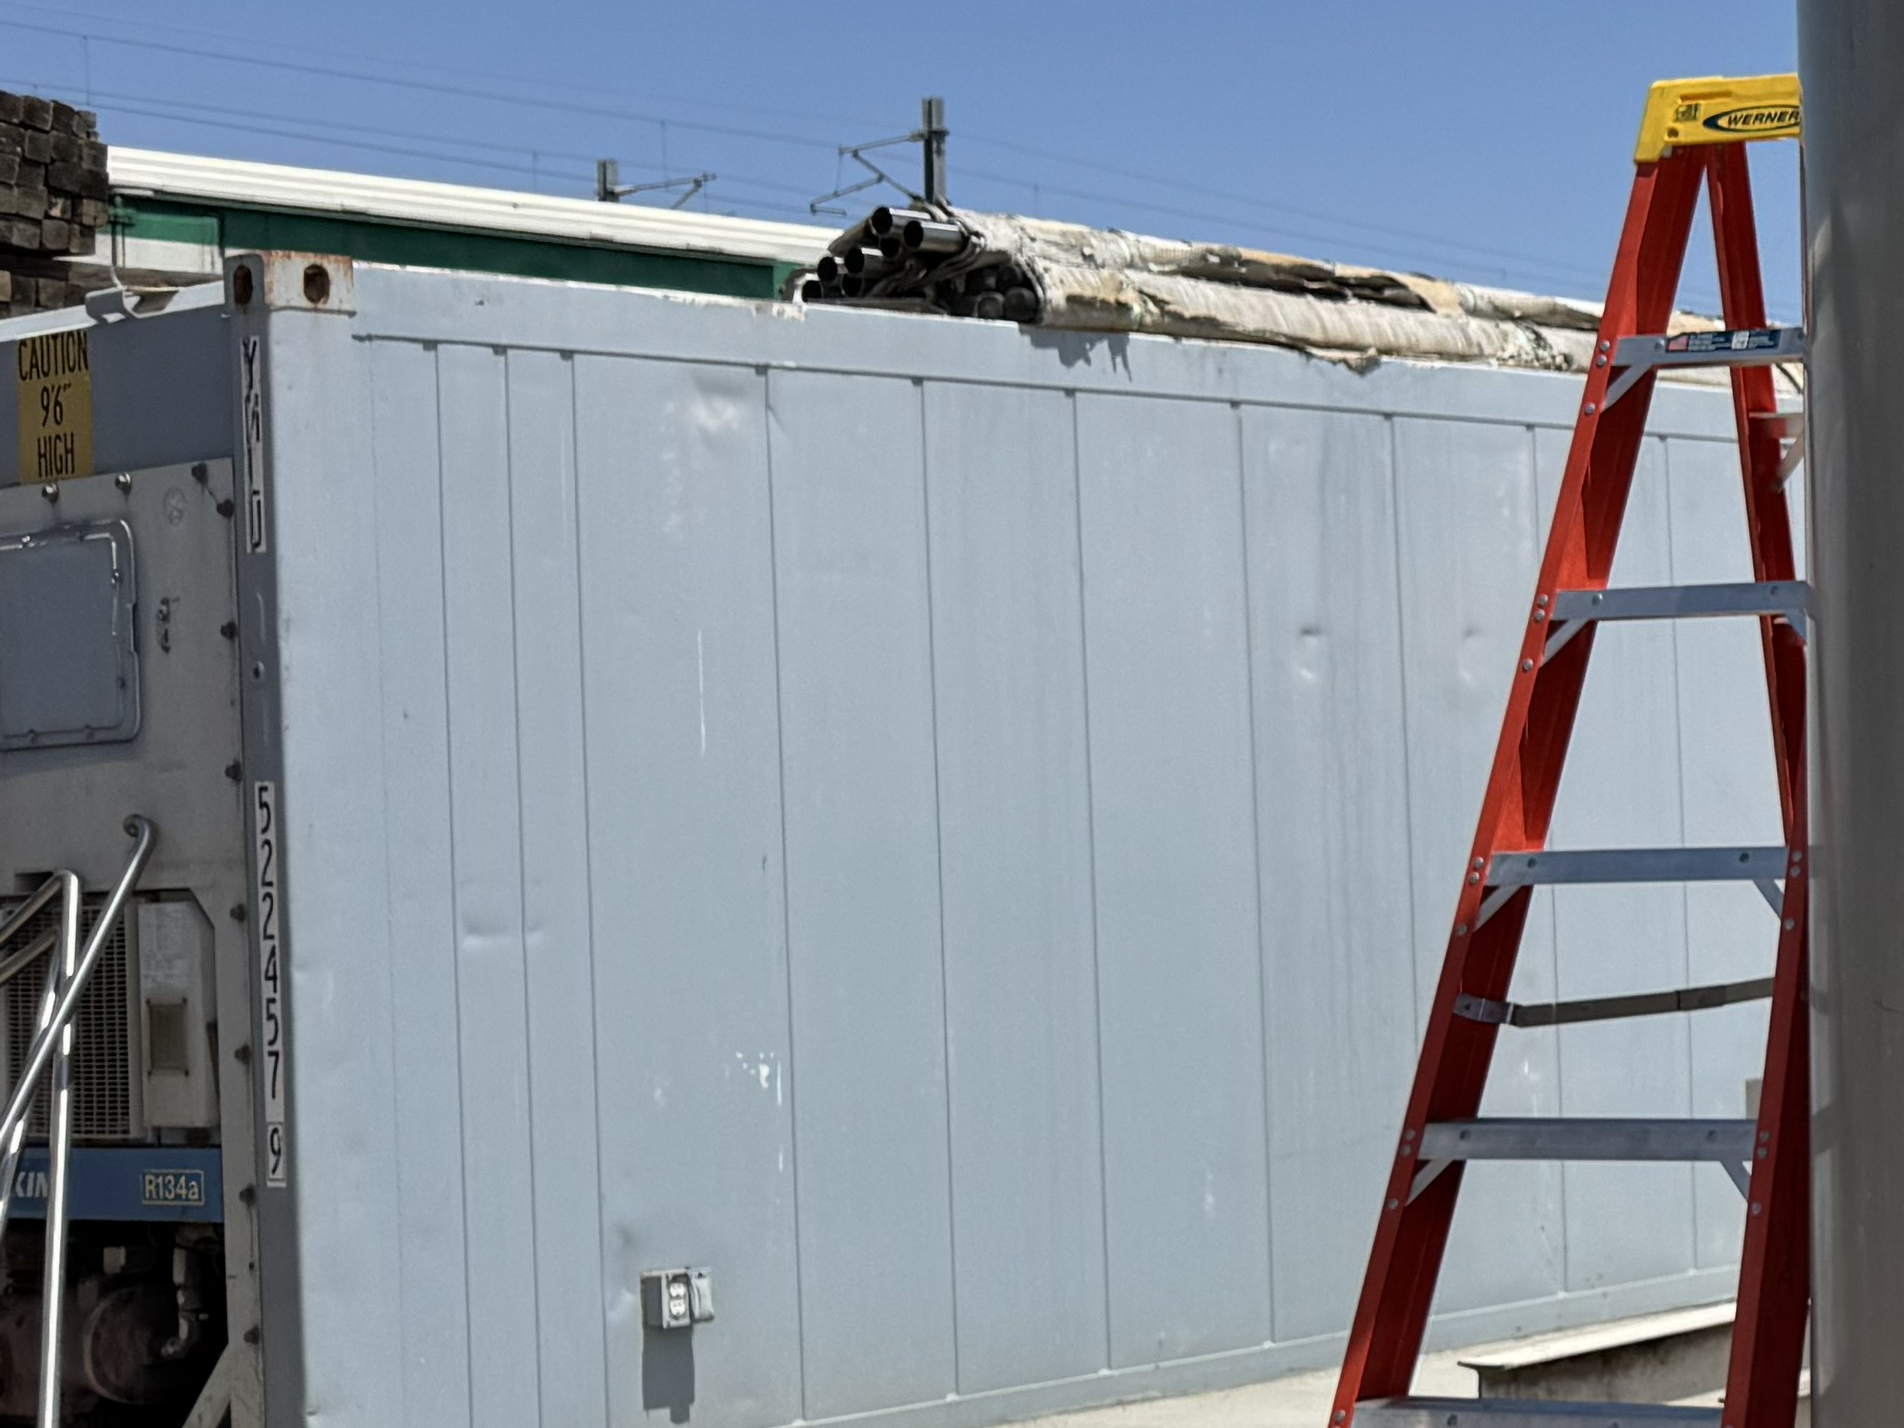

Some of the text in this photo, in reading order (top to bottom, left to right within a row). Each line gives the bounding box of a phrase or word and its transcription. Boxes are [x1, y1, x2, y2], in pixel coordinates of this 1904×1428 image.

[1727, 110, 1800, 127] WERNER
[18, 330, 89, 382] CAUTION
[37, 431, 75, 479] HIGH
[269, 1127, 282, 1174] 9
[15, 1171, 48, 1198] KIN
[145, 1174, 200, 1200] R134a
